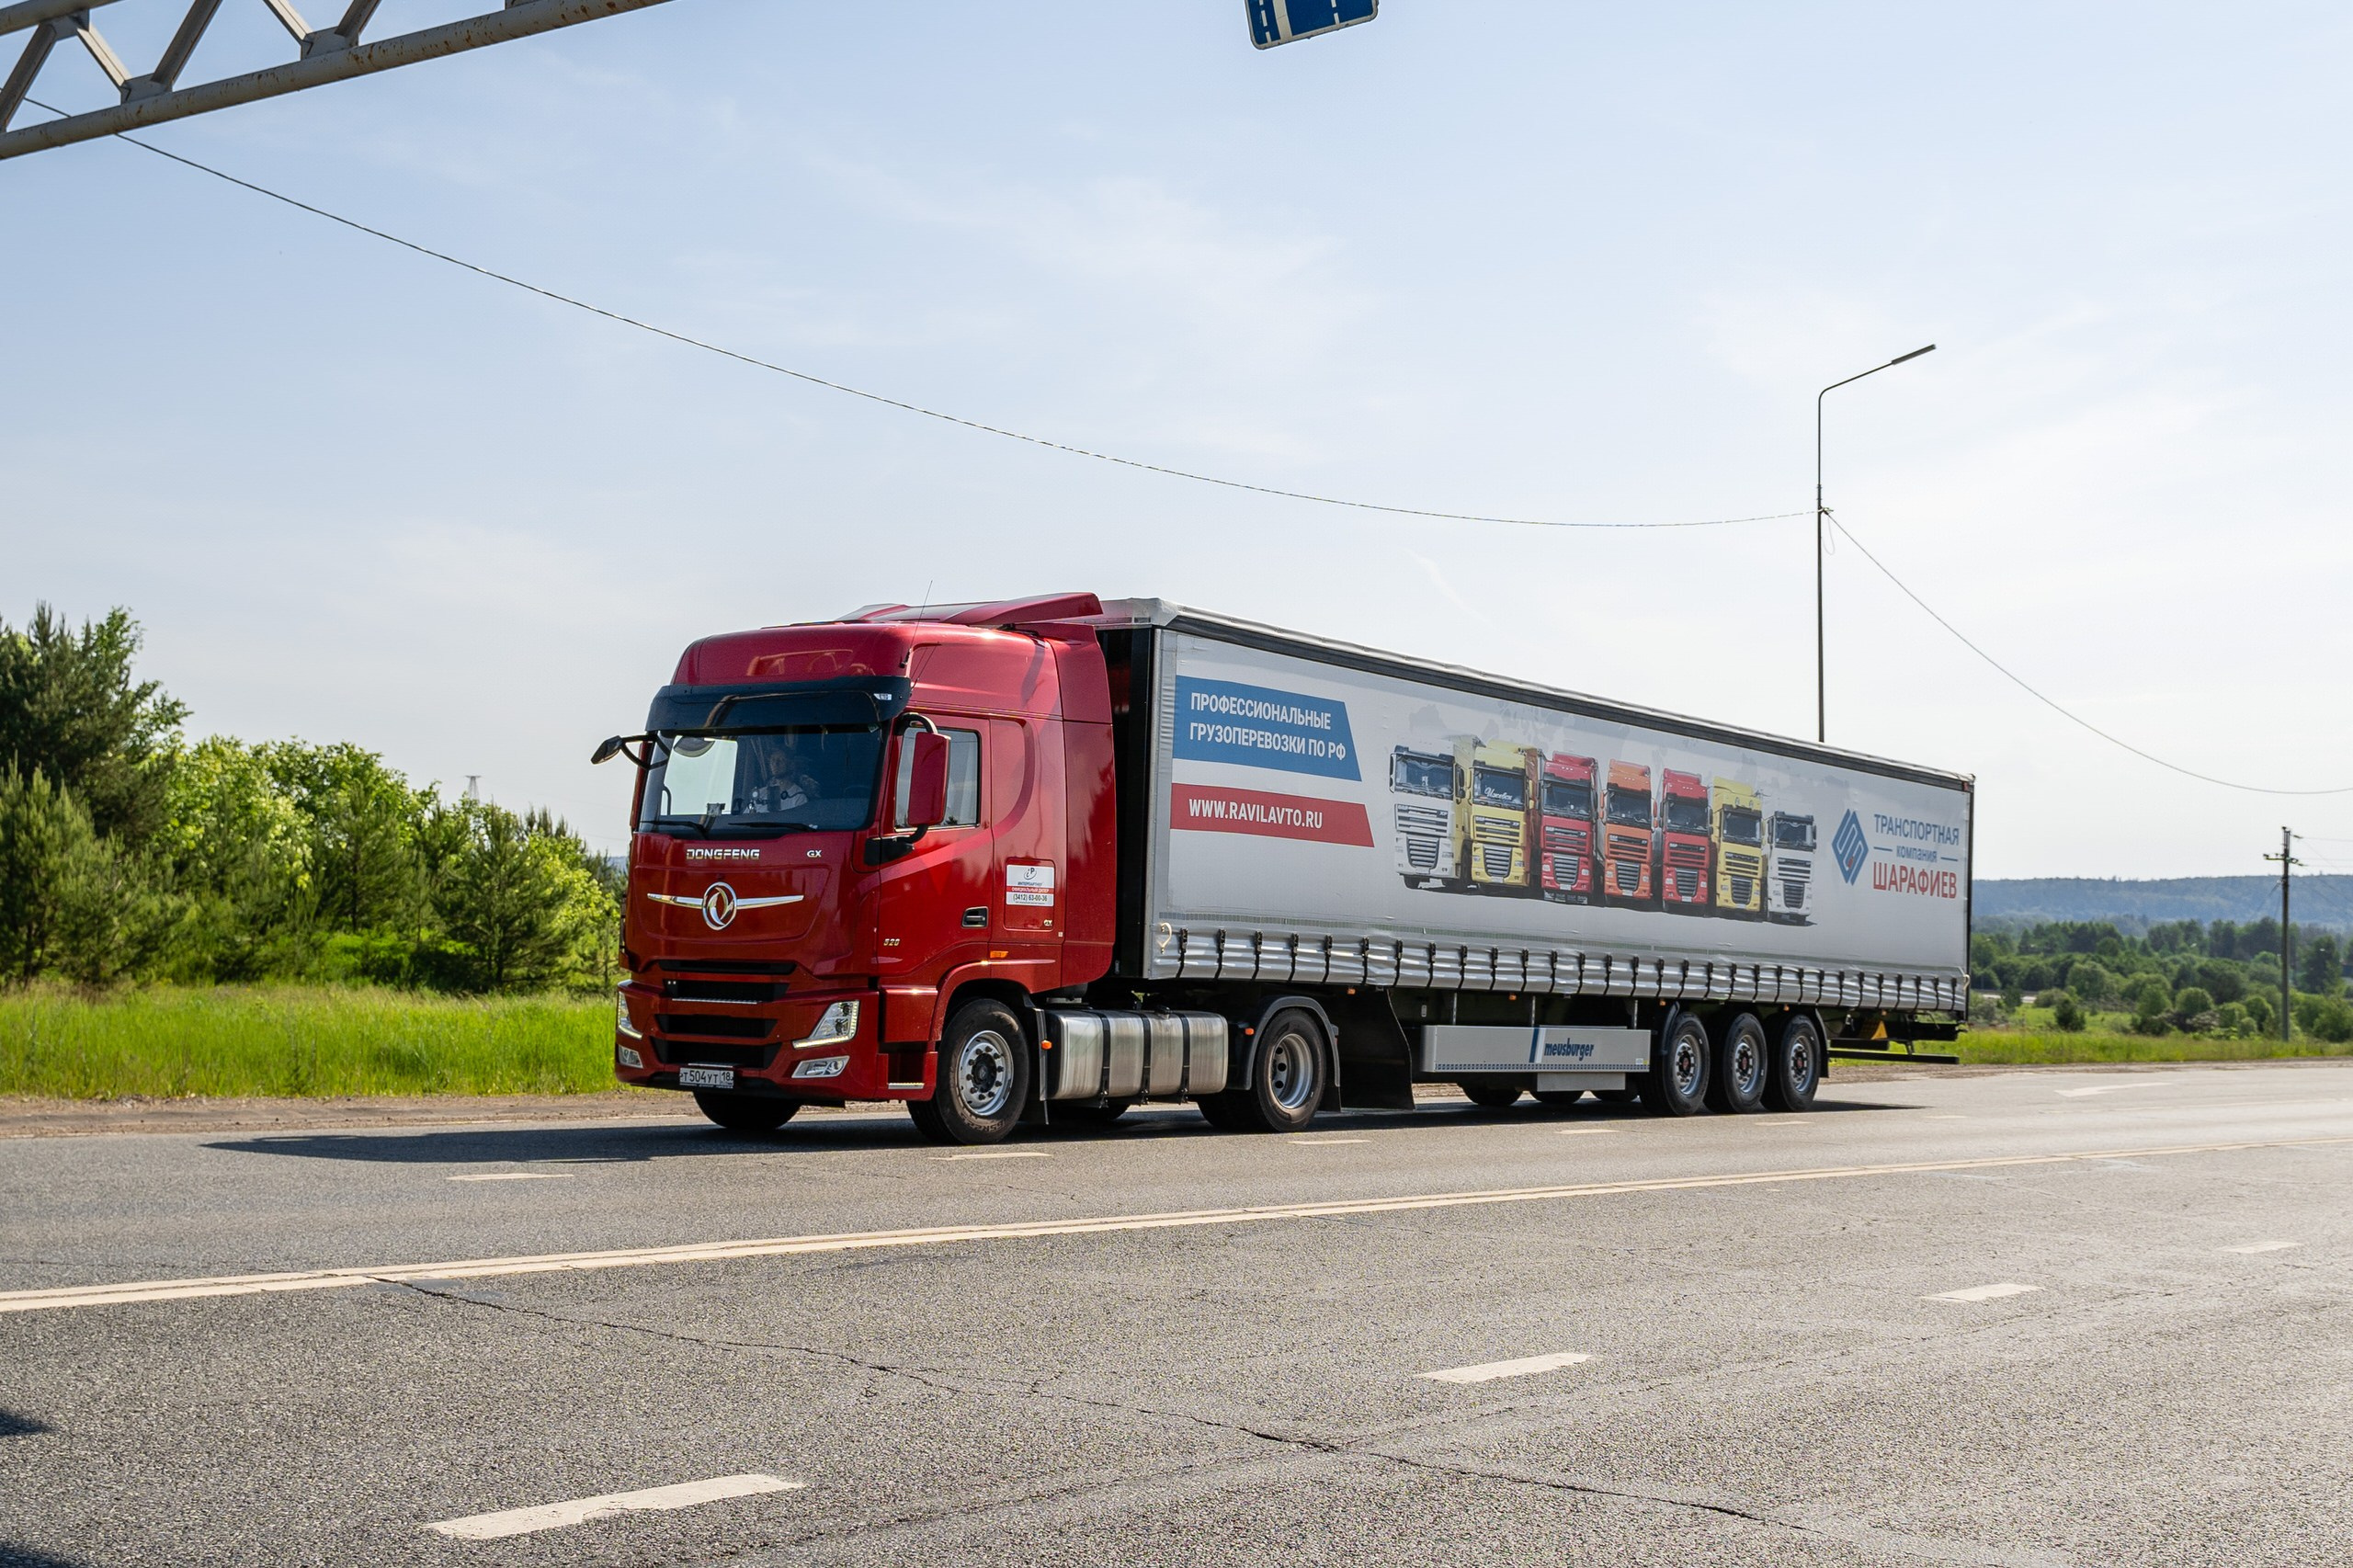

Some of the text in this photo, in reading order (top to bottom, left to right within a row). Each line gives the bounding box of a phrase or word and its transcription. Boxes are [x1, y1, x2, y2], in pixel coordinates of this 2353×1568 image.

[1191, 692, 1332, 731] ПРОФЕССИОНАЛЬНЫЕ
[1189, 722, 1347, 761] ГРУЗОПЕРЕВОЗКИ ПО РФ
[1188, 799, 1323, 829] WWW.RAVILAVTO.RU
[1874, 813, 1960, 846] ТРАНСПОРТНАЯ
[687, 848, 760, 860] DONGFENG
[807, 849, 822, 858] GX
[1873, 861, 1958, 899] ШАРАФИЕВ
[1544, 1038, 1595, 1061] meusburger
